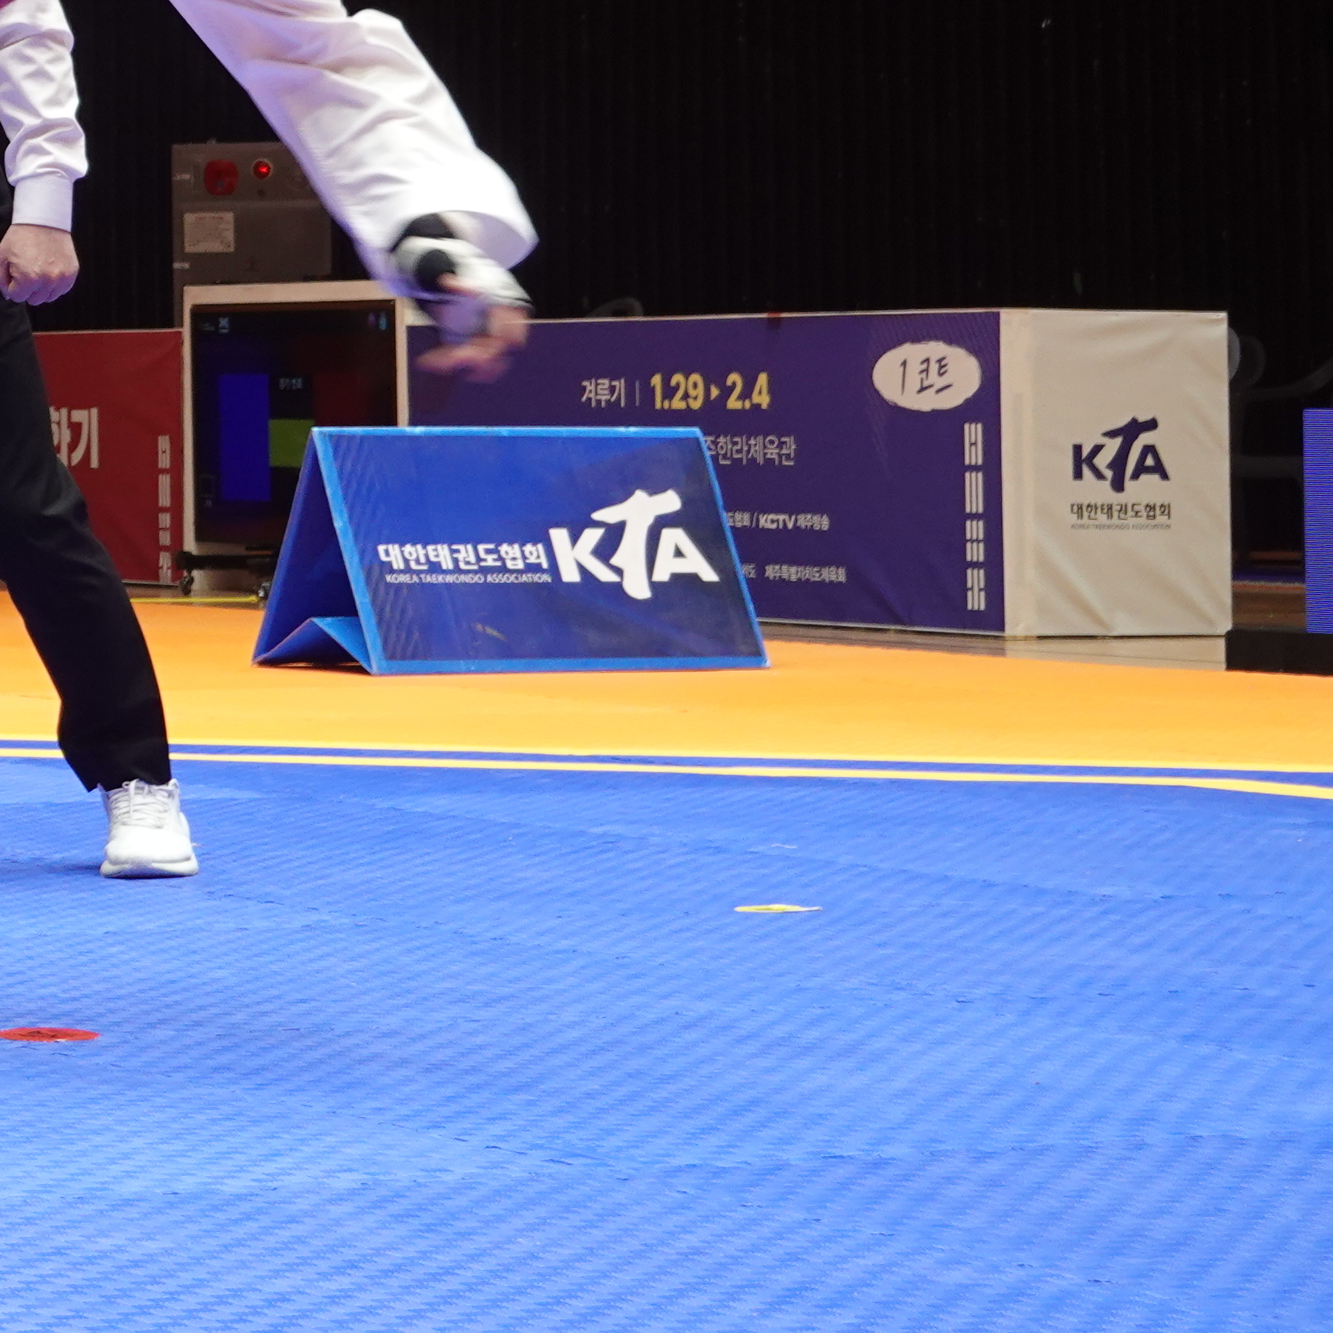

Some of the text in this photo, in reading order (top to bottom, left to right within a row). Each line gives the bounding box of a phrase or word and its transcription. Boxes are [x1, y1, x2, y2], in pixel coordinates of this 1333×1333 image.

[581, 371, 772, 411] 겨루기 1.29 2.4
[915, 356, 954, 395] 코트
[1071, 416, 1171, 494] KTA
[759, 512, 796, 530] KCTV
[1070, 502, 1172, 521] 대한태권도협회
[377, 542, 550, 572] 대한태권도협회
[548, 488, 721, 601] KTA
[384, 573, 552, 585] KOREA TAEKWONDO ASSOCIATION
